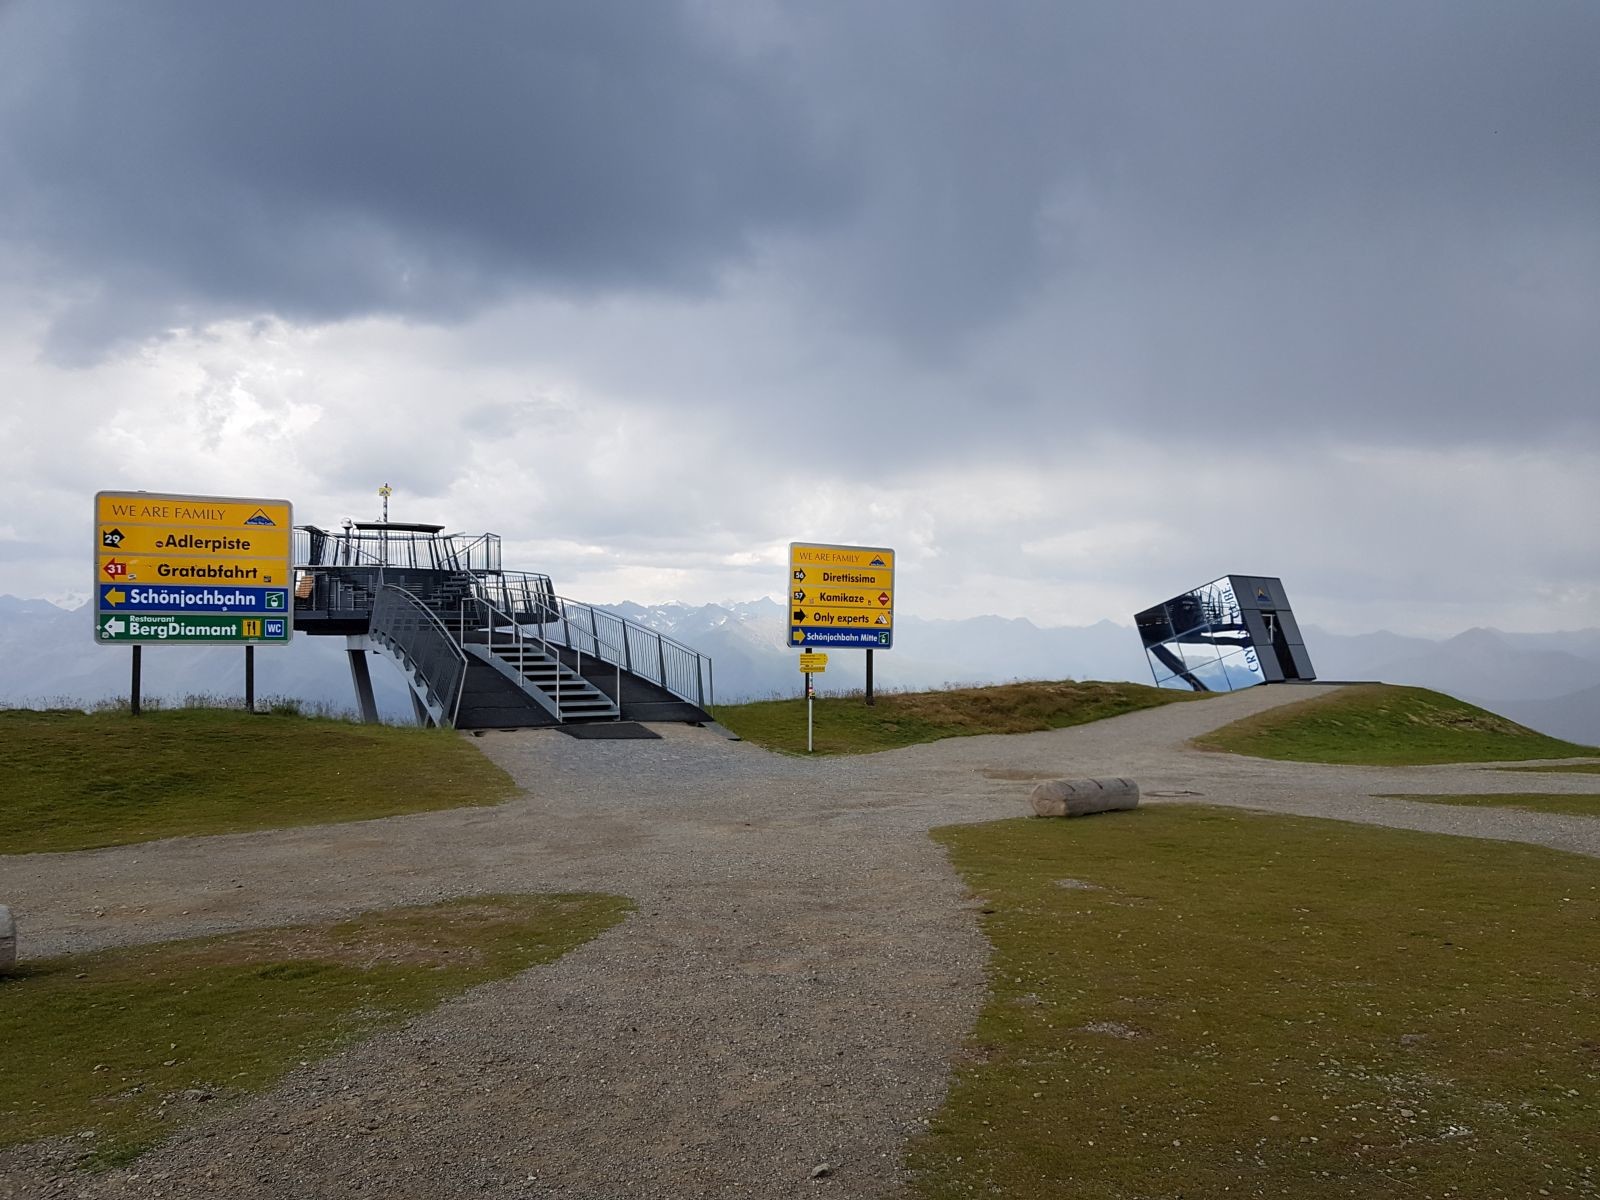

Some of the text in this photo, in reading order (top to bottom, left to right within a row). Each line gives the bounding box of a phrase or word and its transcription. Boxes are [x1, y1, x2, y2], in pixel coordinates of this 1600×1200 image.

[112, 505, 226, 520] WE ARE FAMILY
[104, 534, 120, 544] 29
[165, 534, 251, 552] Adlerpiste
[799, 552, 860, 562] WE ARE FAMILY
[107, 565, 122, 574] 31
[157, 563, 258, 579] Gratabfahrt
[823, 572, 876, 584] Direttissima
[130, 589, 256, 607] Schönjochbahn
[819, 592, 864, 603] Kamikaze
[129, 615, 175, 623] Restaurant
[814, 612, 869, 625] Only experts
[129, 622, 237, 639] BergDiamant
[267, 623, 282, 633] WC
[806, 632, 878, 644] Schönjochbahn Mitte
